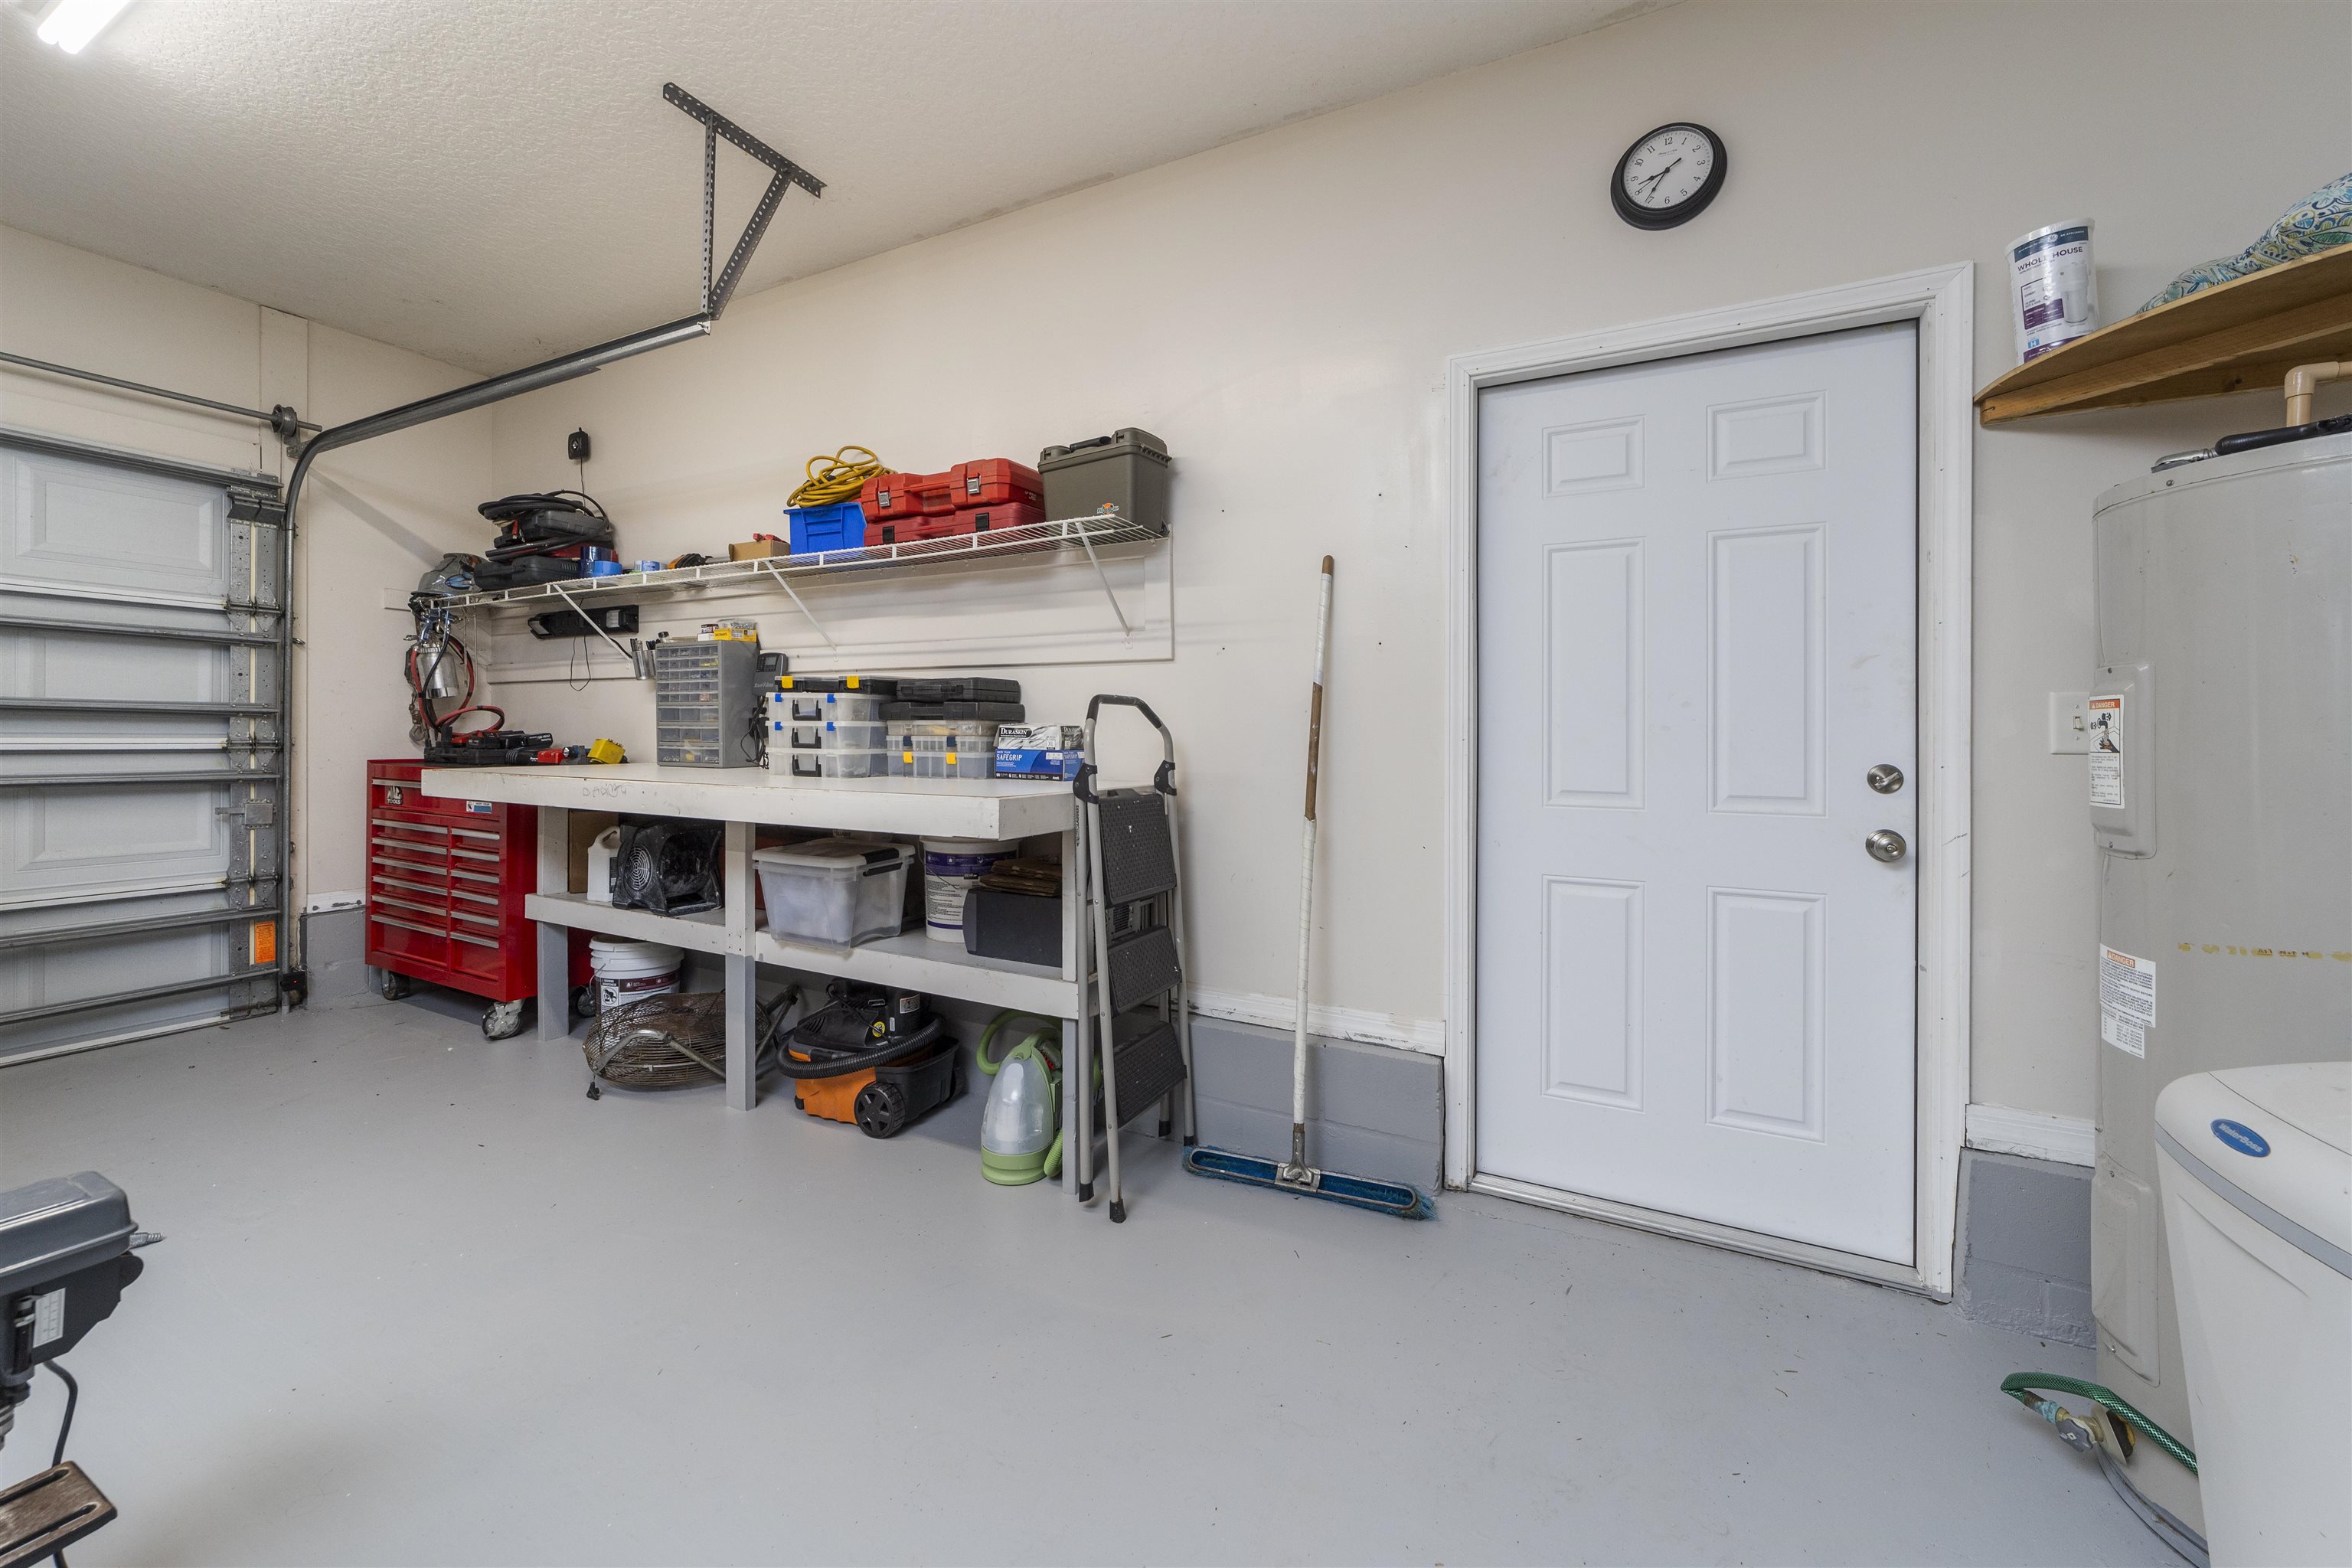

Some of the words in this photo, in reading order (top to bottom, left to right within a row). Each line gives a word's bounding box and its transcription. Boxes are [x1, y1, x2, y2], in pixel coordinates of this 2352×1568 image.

[1664, 137, 1673, 145] 12
[1681, 137, 1687, 145] 1
[1647, 145, 1655, 154] 11
[1635, 158, 1644, 167] 10
[1680, 188, 1687, 197] 5
[1648, 196, 1655, 204] 7
[1664, 196, 1671, 204] 6
[2017, 256, 2047, 272] WHOL
[2053, 247, 2083, 258] HOUSE
[2111, 952, 2135, 968] DANGER
